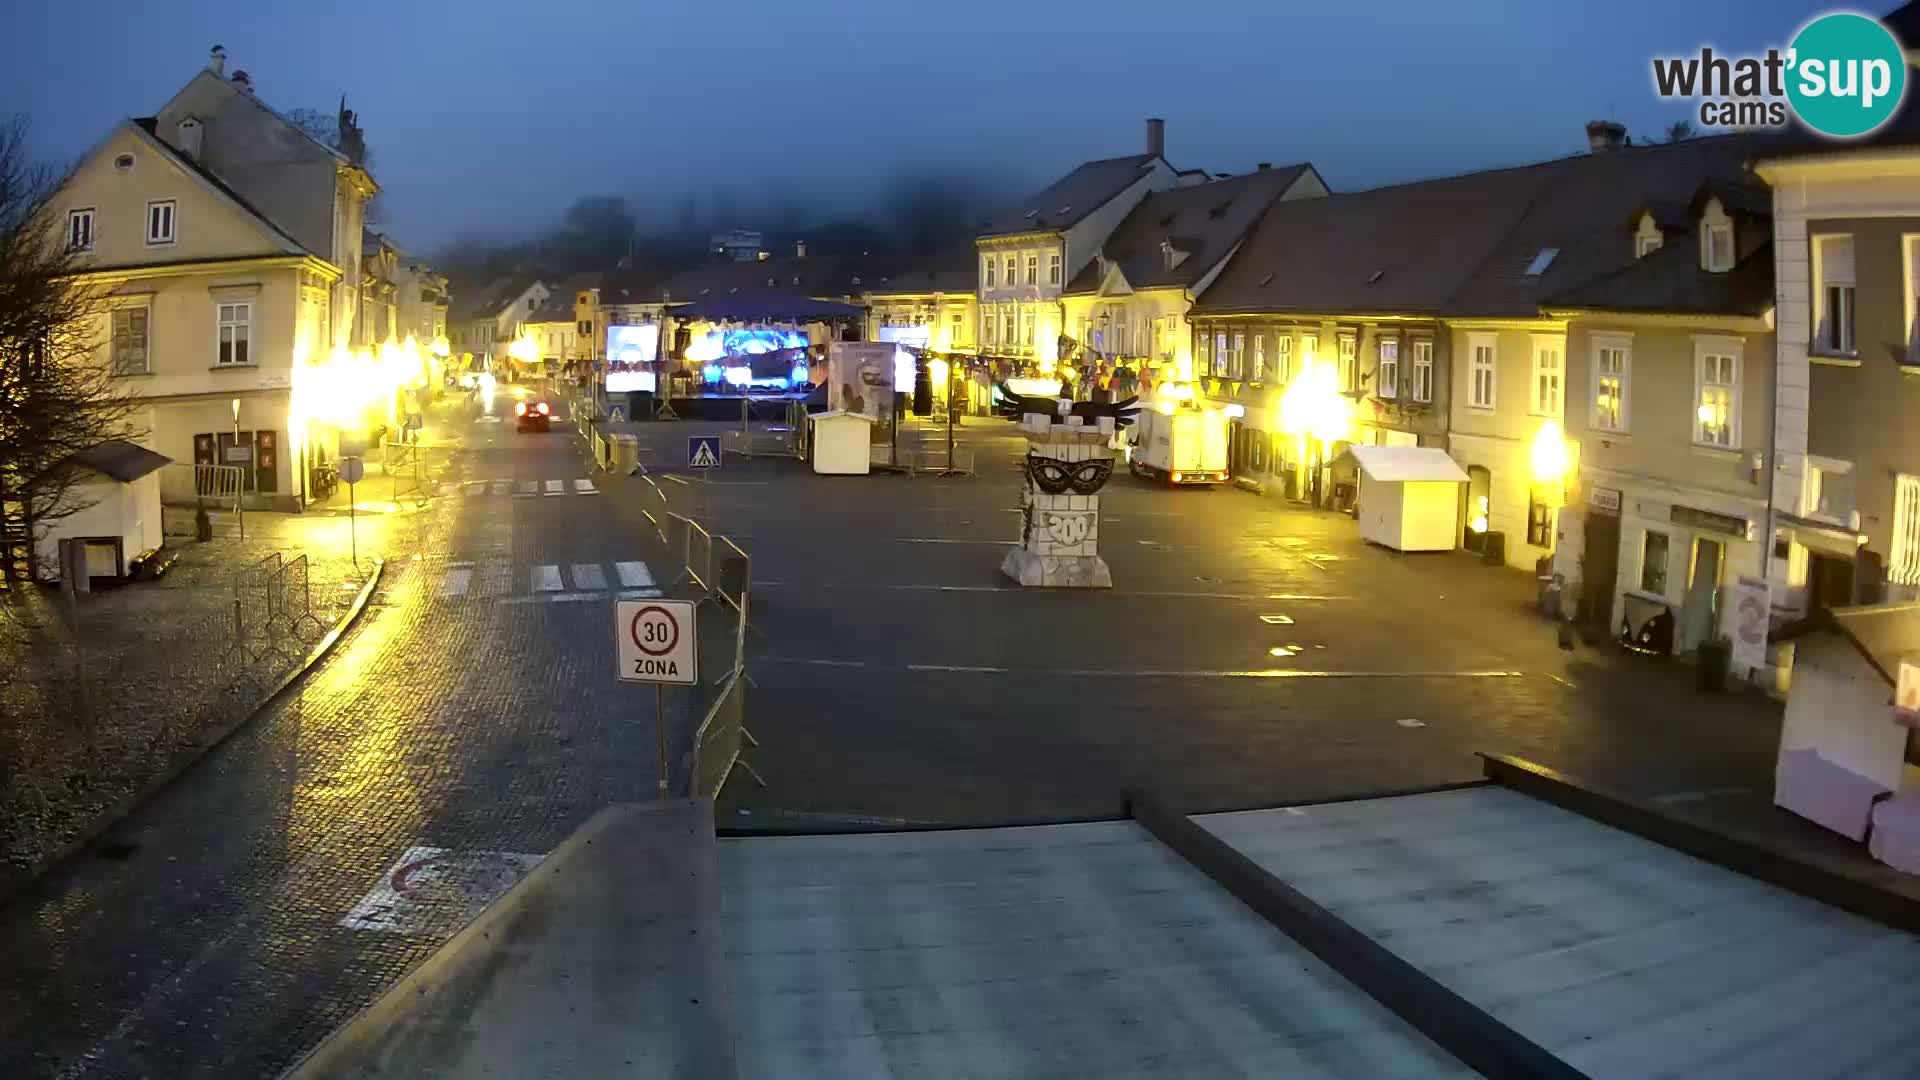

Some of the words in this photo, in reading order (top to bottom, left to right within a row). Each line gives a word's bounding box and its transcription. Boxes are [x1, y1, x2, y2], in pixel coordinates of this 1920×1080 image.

[1048, 516, 1089, 545] 200
[644, 622, 668, 643] 30
[634, 659, 679, 677] ZONA
